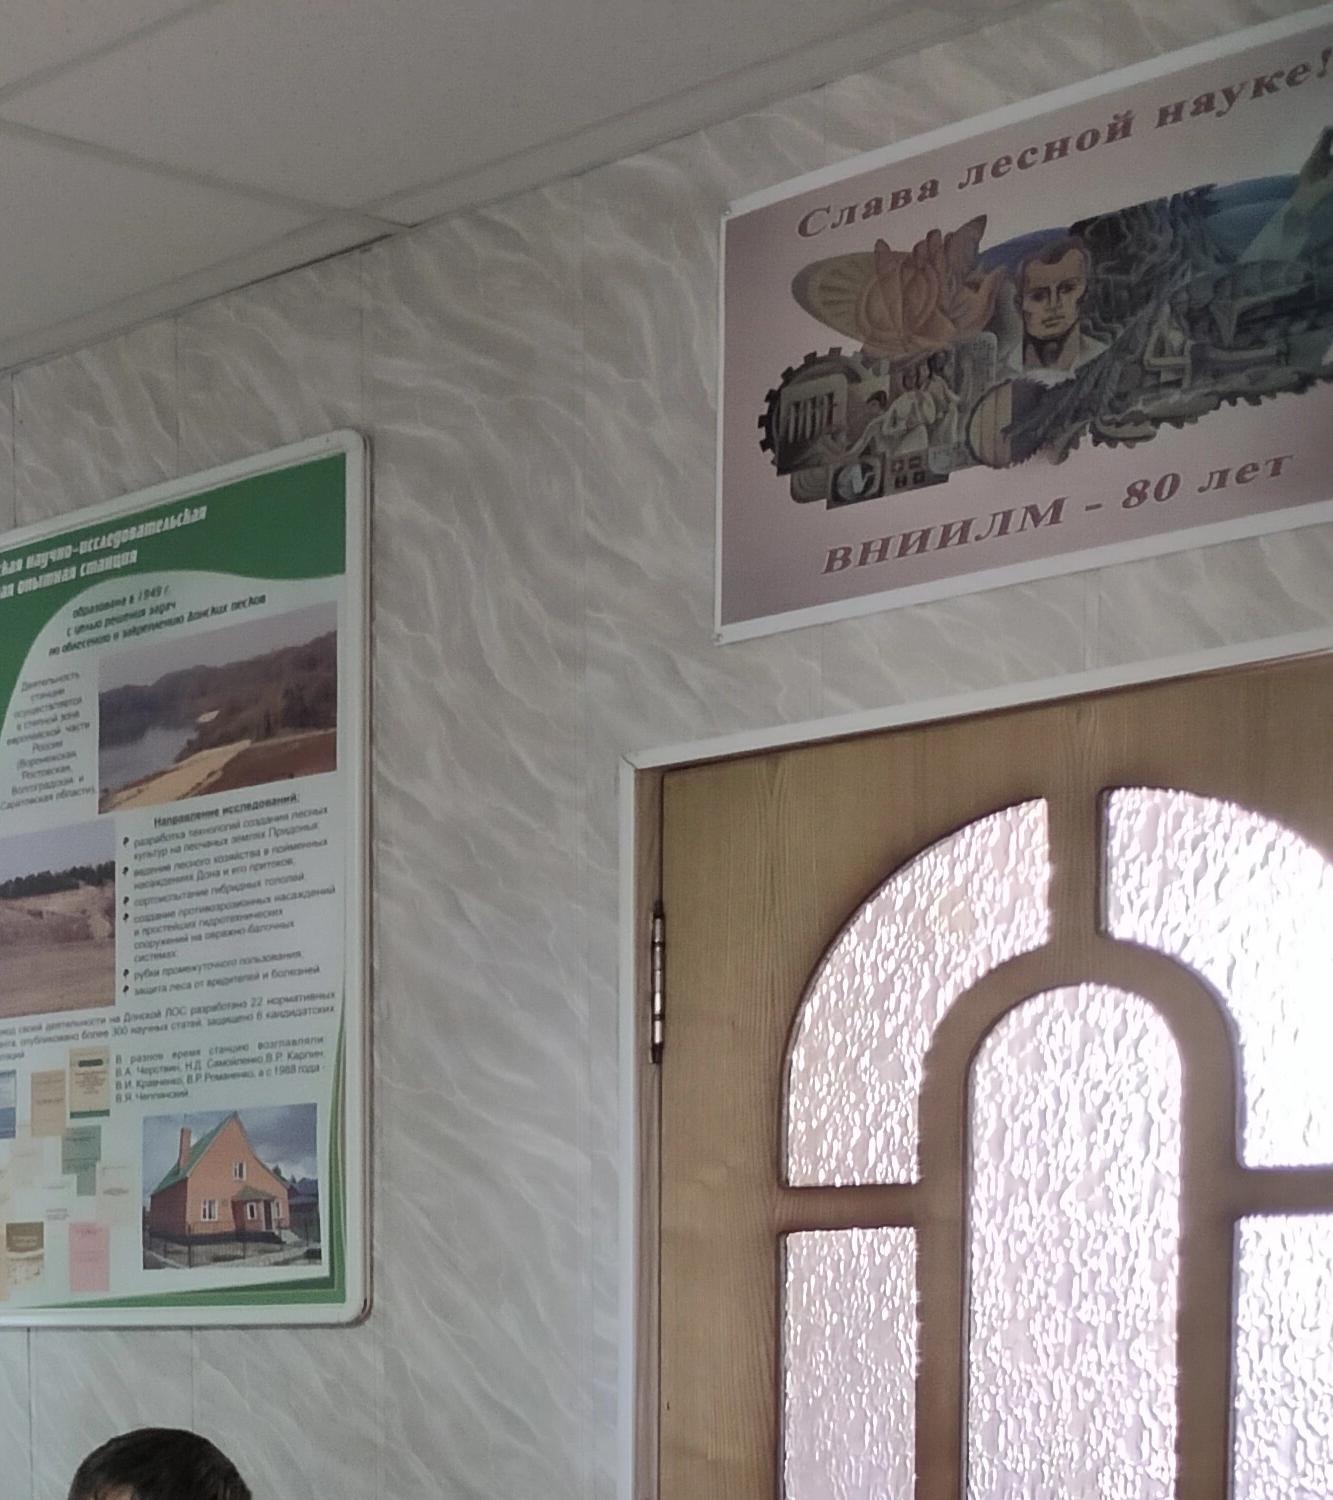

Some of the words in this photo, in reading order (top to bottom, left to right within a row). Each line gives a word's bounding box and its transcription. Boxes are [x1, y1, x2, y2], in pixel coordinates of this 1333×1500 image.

[796, 175, 941, 240] Слава
[956, 108, 1135, 191] лесной
[1153, 47, 1333, 131] науке!
[820, 496, 1070, 576] ВНИИЛМ
[1121, 471, 1182, 511] 80
[1195, 452, 1295, 495] лет
[25, 506, 206, 568] научно-исследовательская
[17, 566, 76, 594] опытная
[79, 549, 137, 576] станция
[186, 604, 227, 622] Донских
[133, 831, 185, 848] разработка
[188, 820, 240, 837] технологий
[242, 813, 289, 827] создания
[290, 806, 327, 819] лесных
[153, 808, 219, 827] Направление
[133, 847, 168, 861] культур
[169, 844, 181, 853] на
[183, 838, 228, 851] песчаных
[173, 857, 211, 870] лесного
[213, 849, 260, 863] хозяйства
[195, 869, 220, 882] Дона
[273, 884, 335, 901] насаждений
[190, 933, 202, 941] на
[134, 984, 167, 995] защита
[168, 981, 192, 991] леса
[206, 971, 260, 987] вредителей
[123, 1009, 161, 1023] Донской
[164, 1006, 186, 1017] ЛОС
[189, 1000, 247, 1015] разработано
[250, 996, 262, 1008] 22
[112, 1025, 128, 1036] 300
[171, 1049, 201, 1059] время
[208, 1043, 249, 1055] станцию
